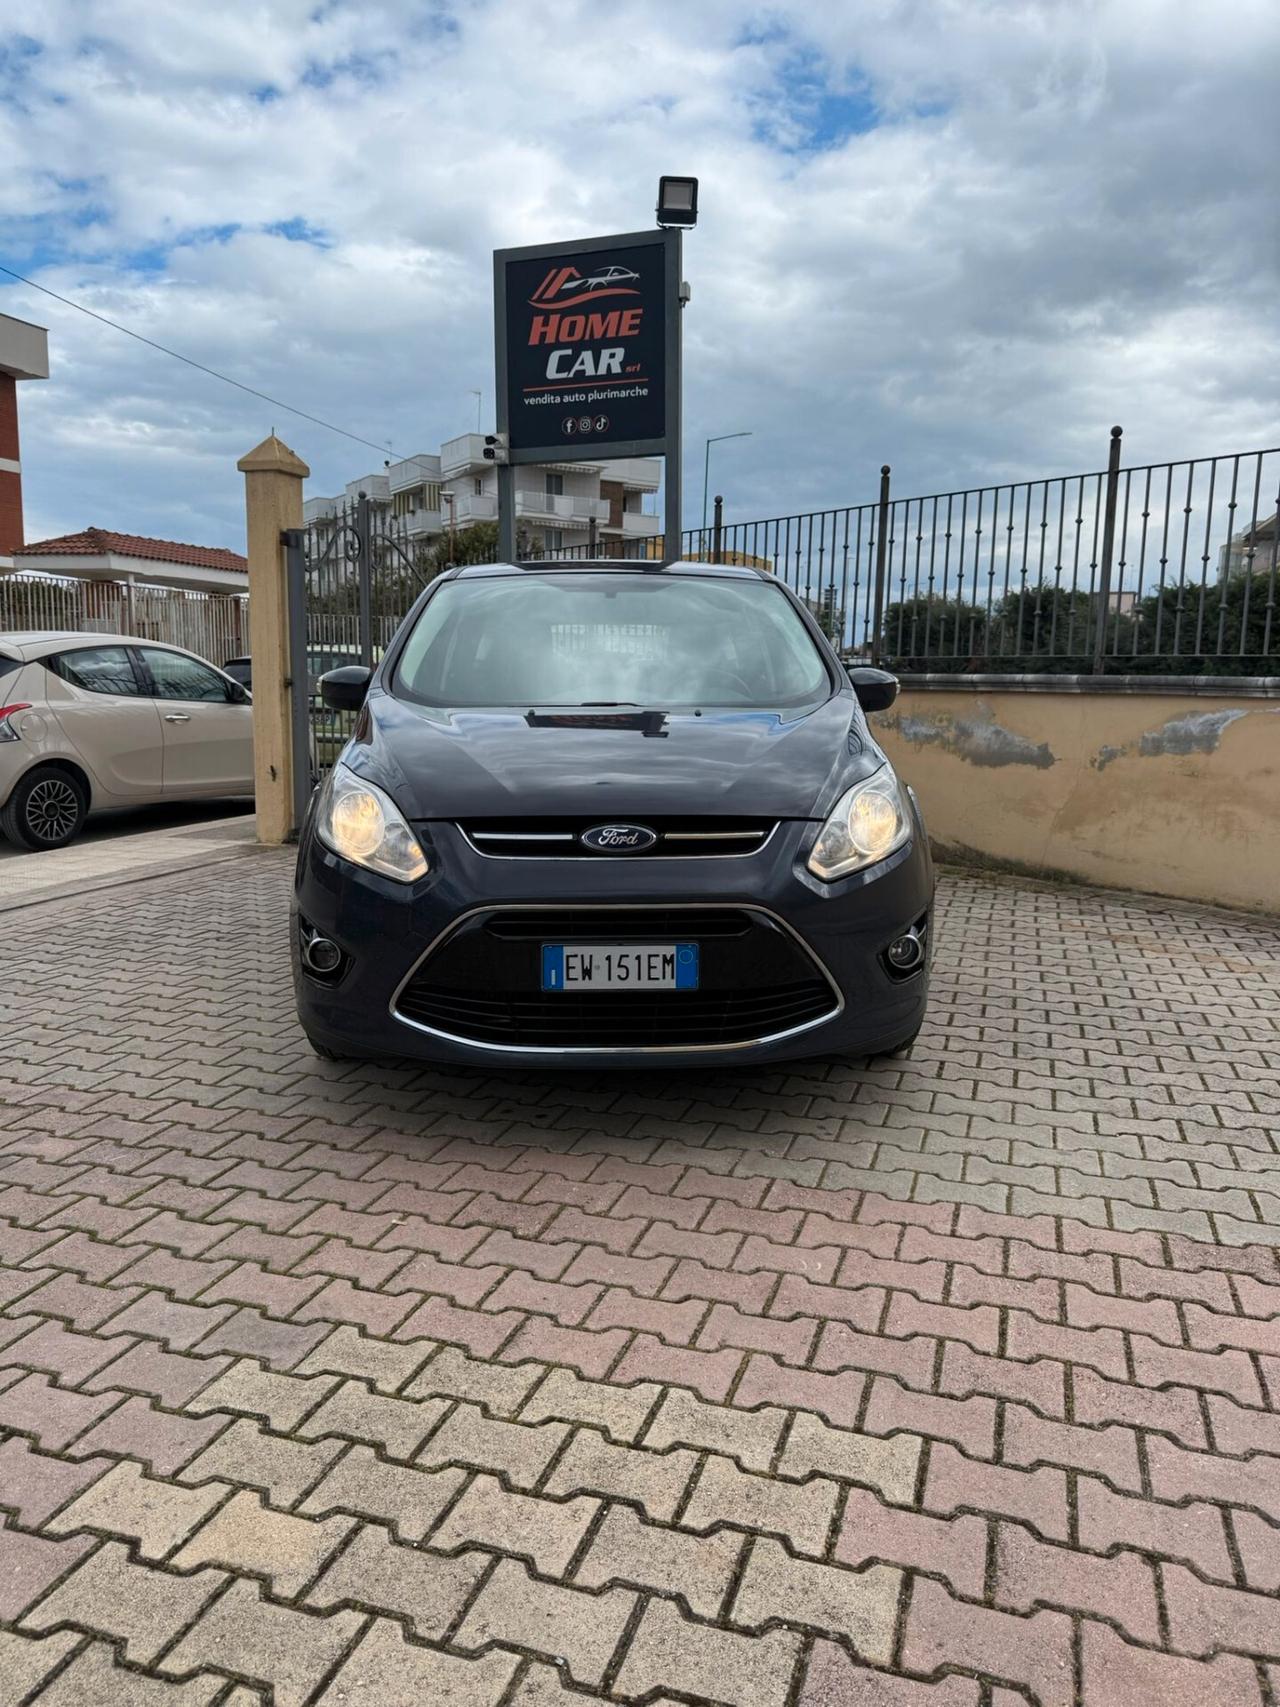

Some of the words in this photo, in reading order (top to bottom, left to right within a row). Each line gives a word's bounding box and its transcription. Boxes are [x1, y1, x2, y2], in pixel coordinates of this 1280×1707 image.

[528, 308, 643, 345] HOME
[546, 347, 625, 379] CAR
[625, 363, 641, 373] srl
[523, 393, 561, 405] vendita
[563, 392, 586, 402] auto
[588, 386, 649, 403] plurimarche
[598, 828, 639, 845] Ford
[565, 954, 593, 981] EW
[605, 953, 675, 981] 151EM
